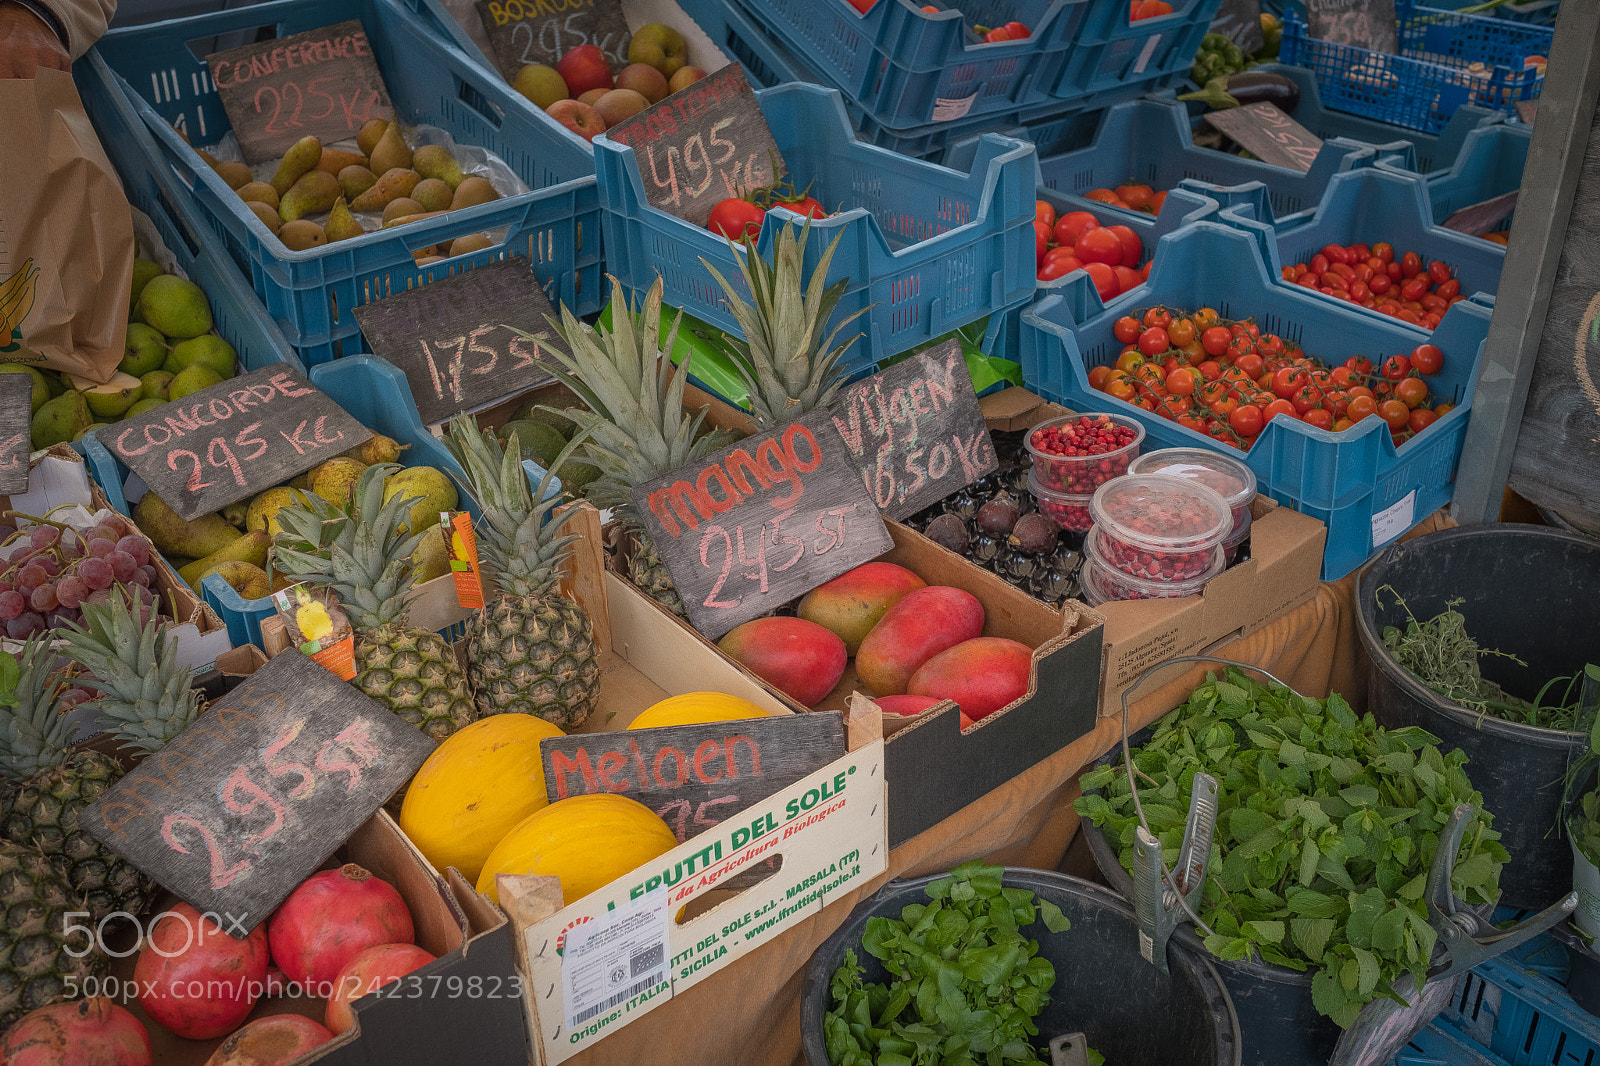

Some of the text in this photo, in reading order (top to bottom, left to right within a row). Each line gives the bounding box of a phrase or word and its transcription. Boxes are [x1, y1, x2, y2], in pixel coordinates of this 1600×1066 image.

[213, 32, 368, 89] CONFERENCE
[117, 372, 318, 457] CONCORDE
[648, 421, 823, 539] mango
[952, 430, 991, 485] KG
[813, 502, 858, 555] ST
[100, 686, 288, 842] ANANAS
[551, 735, 764, 800] Meloen
[675, 886, 694, 903] da
[696, 835, 779, 890] Agricoltura
[782, 799, 847, 841] Biologica
[731, 811, 779, 852] DEL
[696, 933, 720, 953] DEL
[721, 912, 752, 938] SOLE
[753, 898, 778, 920] s.r.l.
[785, 863, 838, 901] MARSALA
[838, 849, 860, 871] (TP)
[569, 1009, 623, 1045] Origine:
[625, 980, 671, 1013] ITALIA
[680, 944, 729, 980] SICILIA
